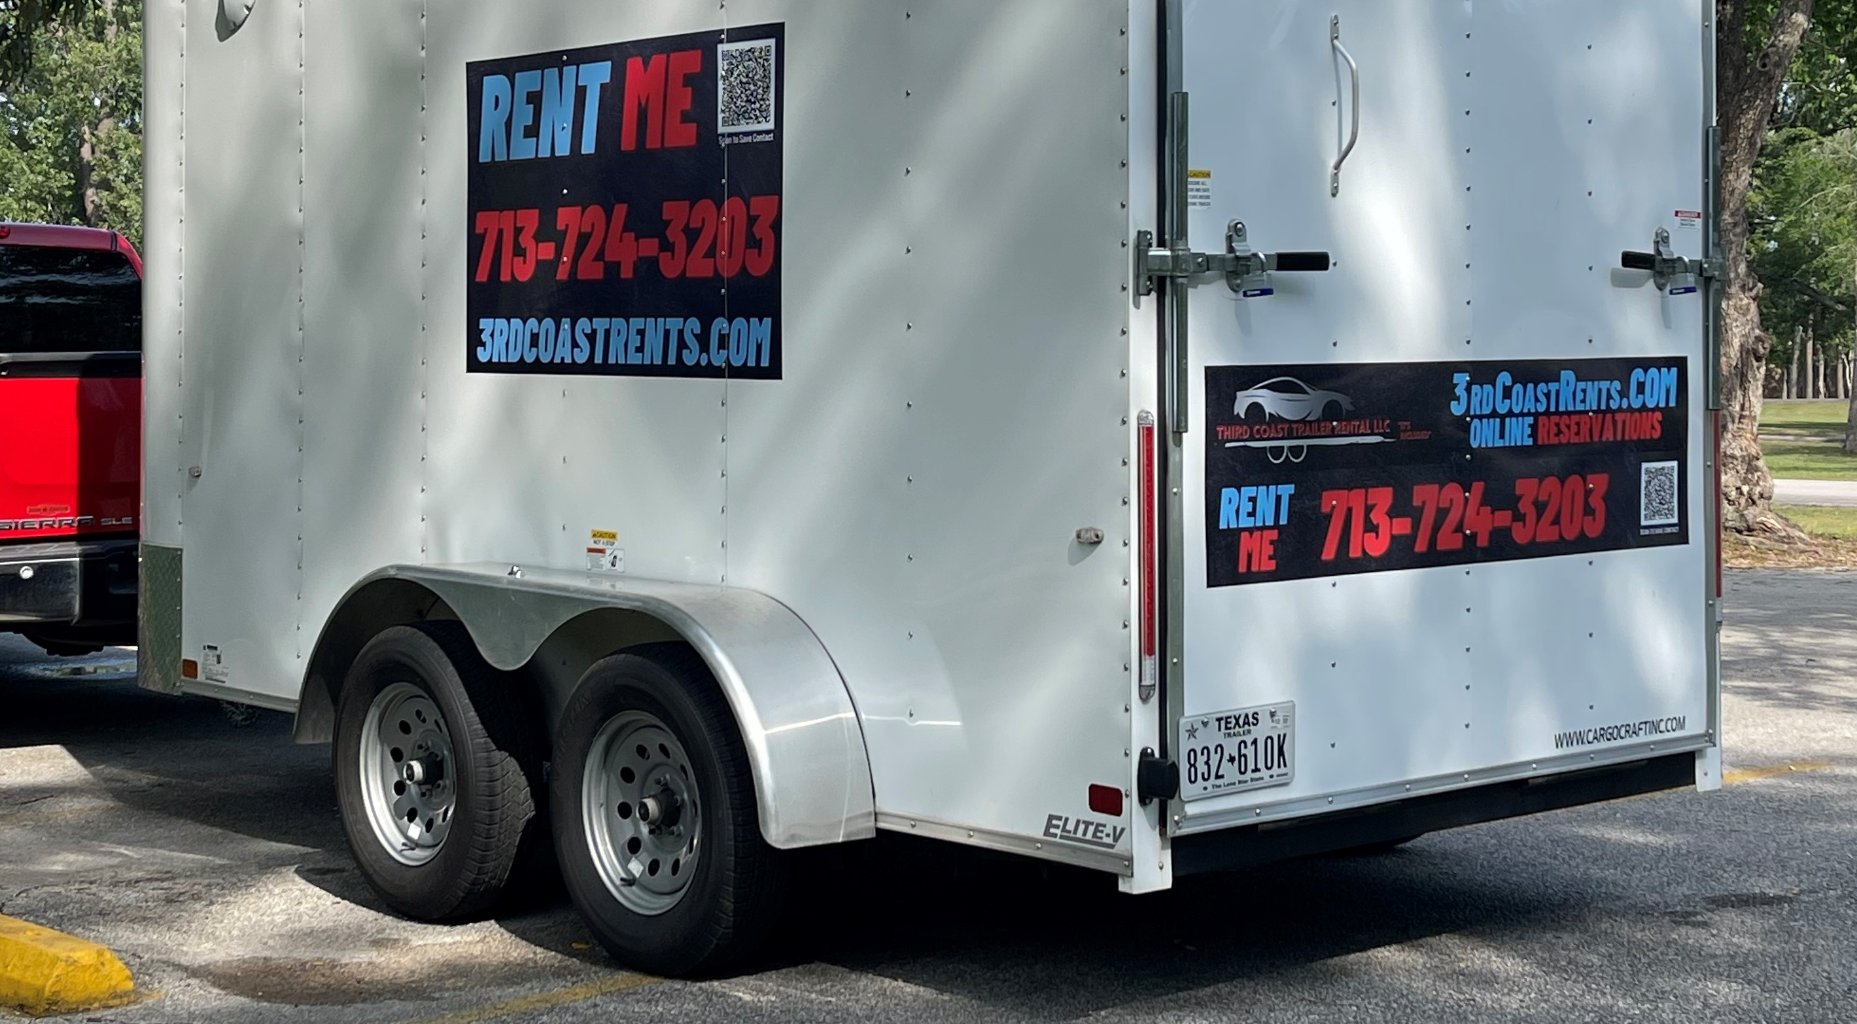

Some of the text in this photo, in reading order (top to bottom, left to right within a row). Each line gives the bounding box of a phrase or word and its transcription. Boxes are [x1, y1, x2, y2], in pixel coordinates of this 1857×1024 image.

[478, 49, 703, 163] RENT ME
[475, 195, 780, 282] 713-724-3203
[476, 317, 772, 367] 3RDCOASTRENTS.COM
[1216, 424, 1250, 440] THIRD
[1253, 423, 1289, 438] COAST
[1292, 422, 1333, 437] TRAILER
[1334, 420, 1370, 435] RENTAL
[1373, 419, 1391, 433] LLC
[1469, 416, 1534, 448] ONLINE
[1537, 411, 1663, 446] RESERVATIONS
[0, 515, 133, 531] SIERRA SLE
[1219, 484, 1295, 529] RENT
[1321, 473, 1610, 560] 713-724-3203
[1238, 529, 1278, 573] ME
[1216, 711, 1260, 732] TEXAS
[1223, 728, 1252, 739] TRAILER
[1554, 715, 1686, 749] WWW.CARGOCRAFTINC.COM
[1043, 813, 1126, 844] ELITE-V
